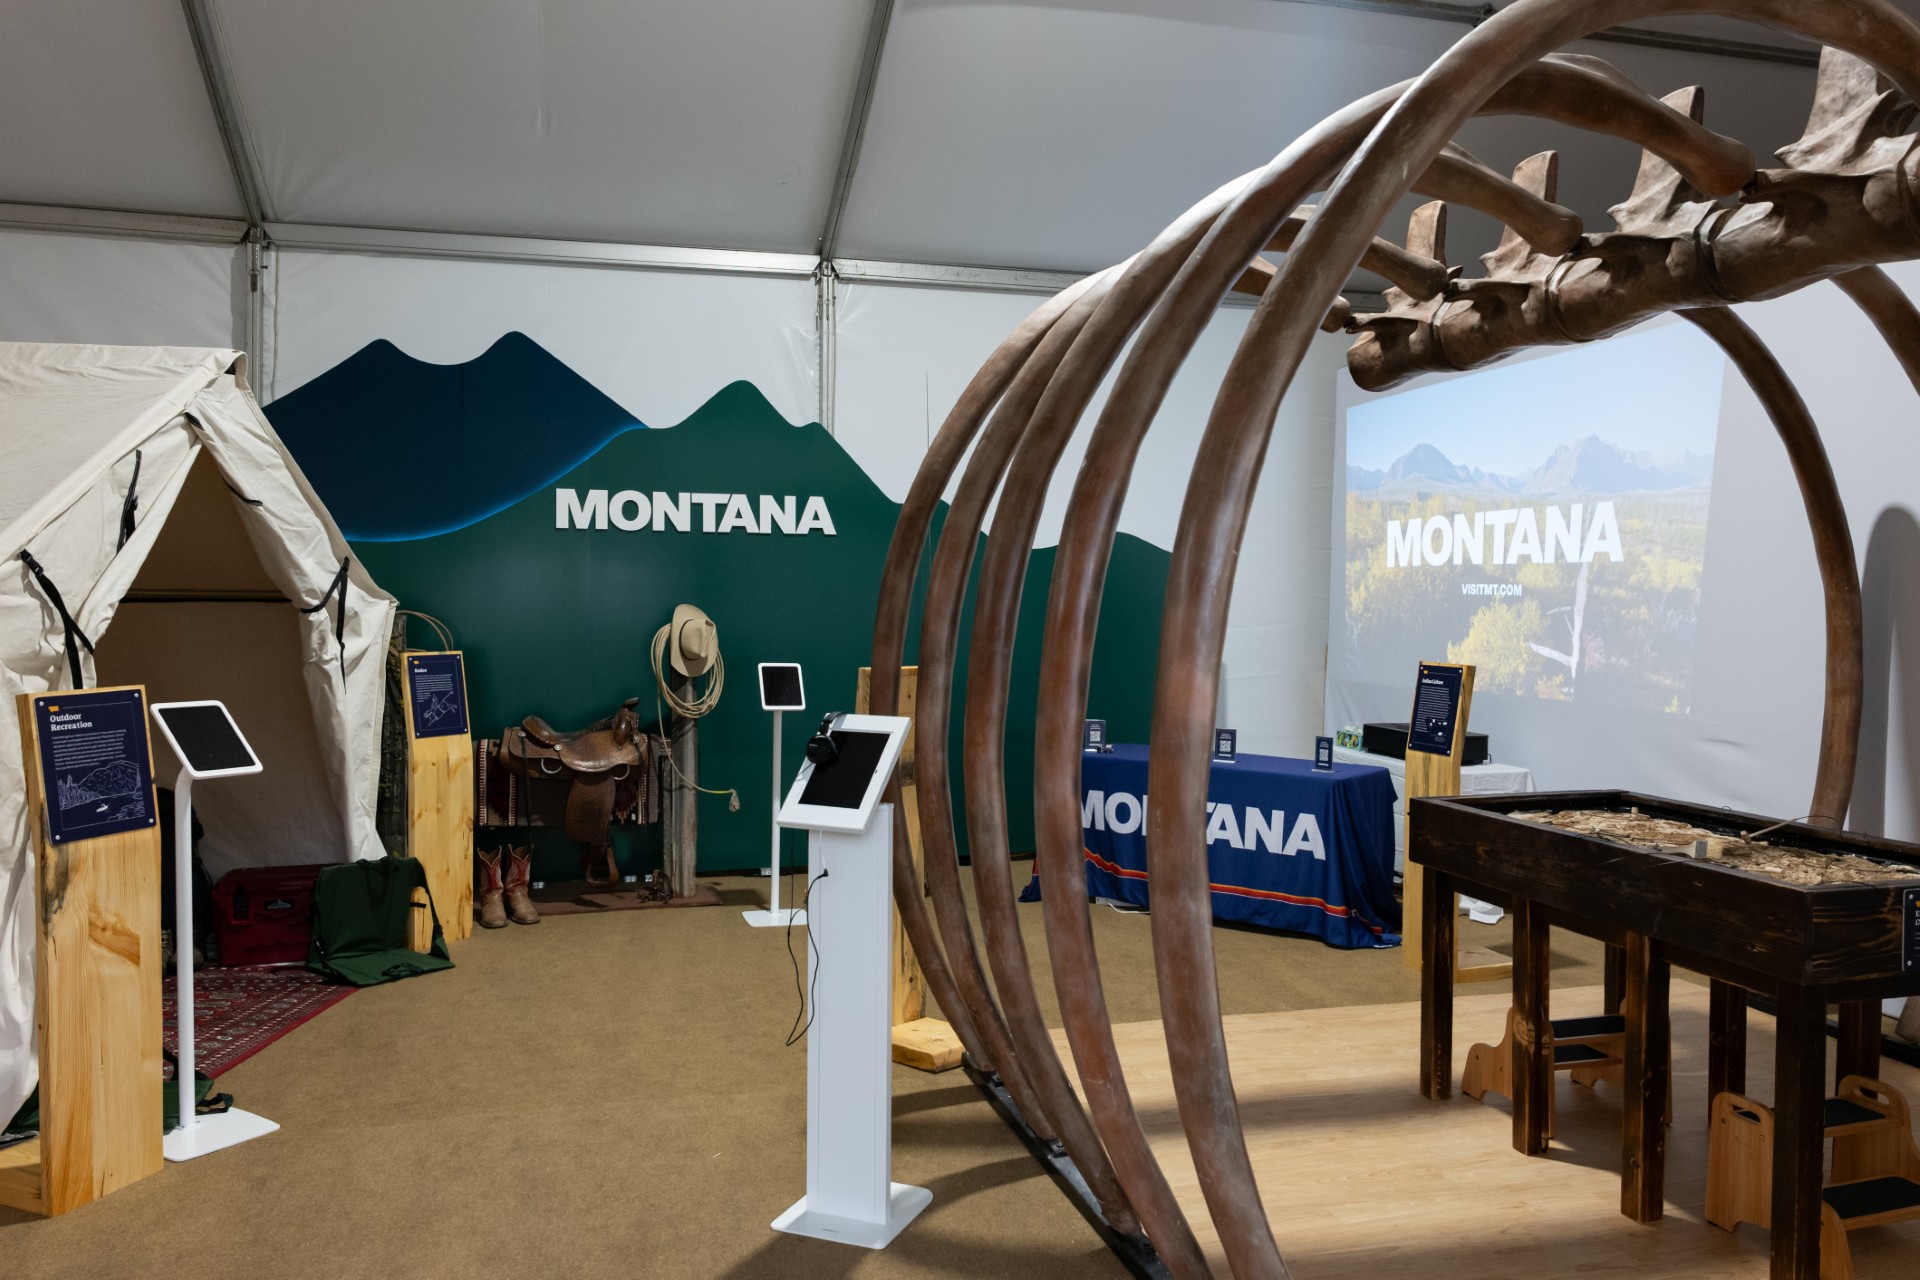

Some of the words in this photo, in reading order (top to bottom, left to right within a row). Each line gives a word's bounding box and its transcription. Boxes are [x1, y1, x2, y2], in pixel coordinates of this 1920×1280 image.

[555, 488, 837, 536] MONTANA
[1386, 501, 1624, 568] MONTANA
[1461, 584, 1522, 596] VISITMT.COM
[49, 713, 82, 723] Outdoor
[50, 720, 93, 731] Recreation
